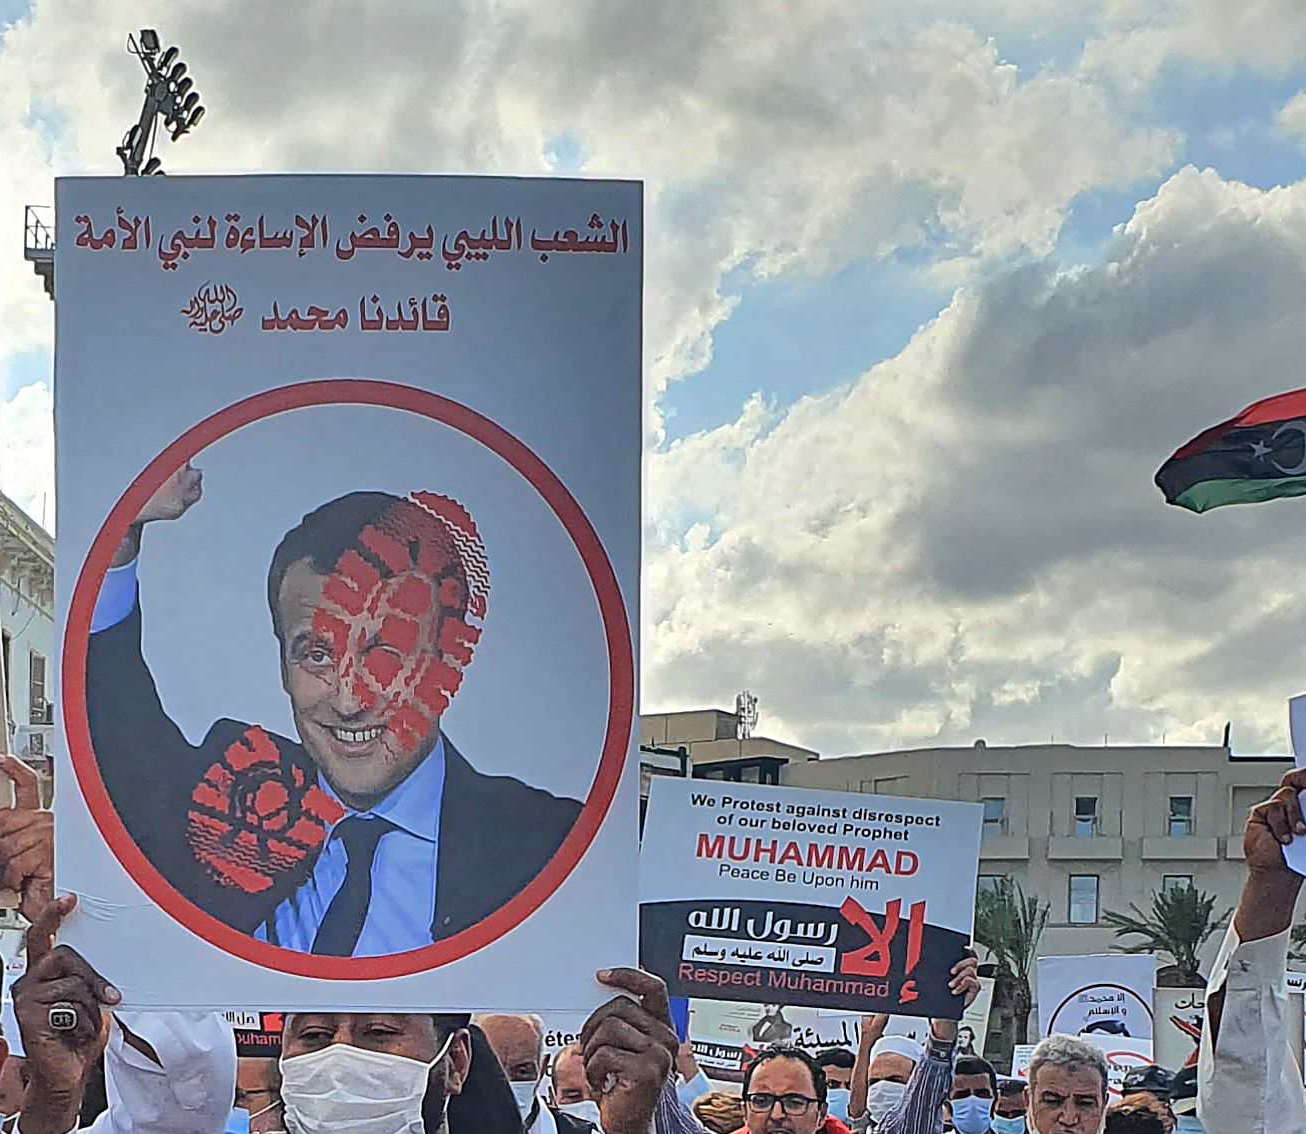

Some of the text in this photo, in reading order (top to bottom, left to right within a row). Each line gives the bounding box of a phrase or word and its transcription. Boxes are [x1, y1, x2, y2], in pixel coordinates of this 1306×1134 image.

[73, 206, 629, 273] الشعب الليبي يرفض الإساءة لنبي الأمة
[261, 298, 349, 333] محمد
[359, 293, 451, 333] قائدنا
[690, 793, 941, 828] We Protest against disrespect
[717, 814, 910, 842] of our beloved Prophet
[696, 833, 919, 876] MUHAMMAD
[719, 864, 879, 891] Peace Be Upon him
[688, 895, 926, 1004] إلا رسول الله
[692, 944, 824, 968] صلى الله عليه وسلم
[678, 962, 889, 998] Respect Muhammad
